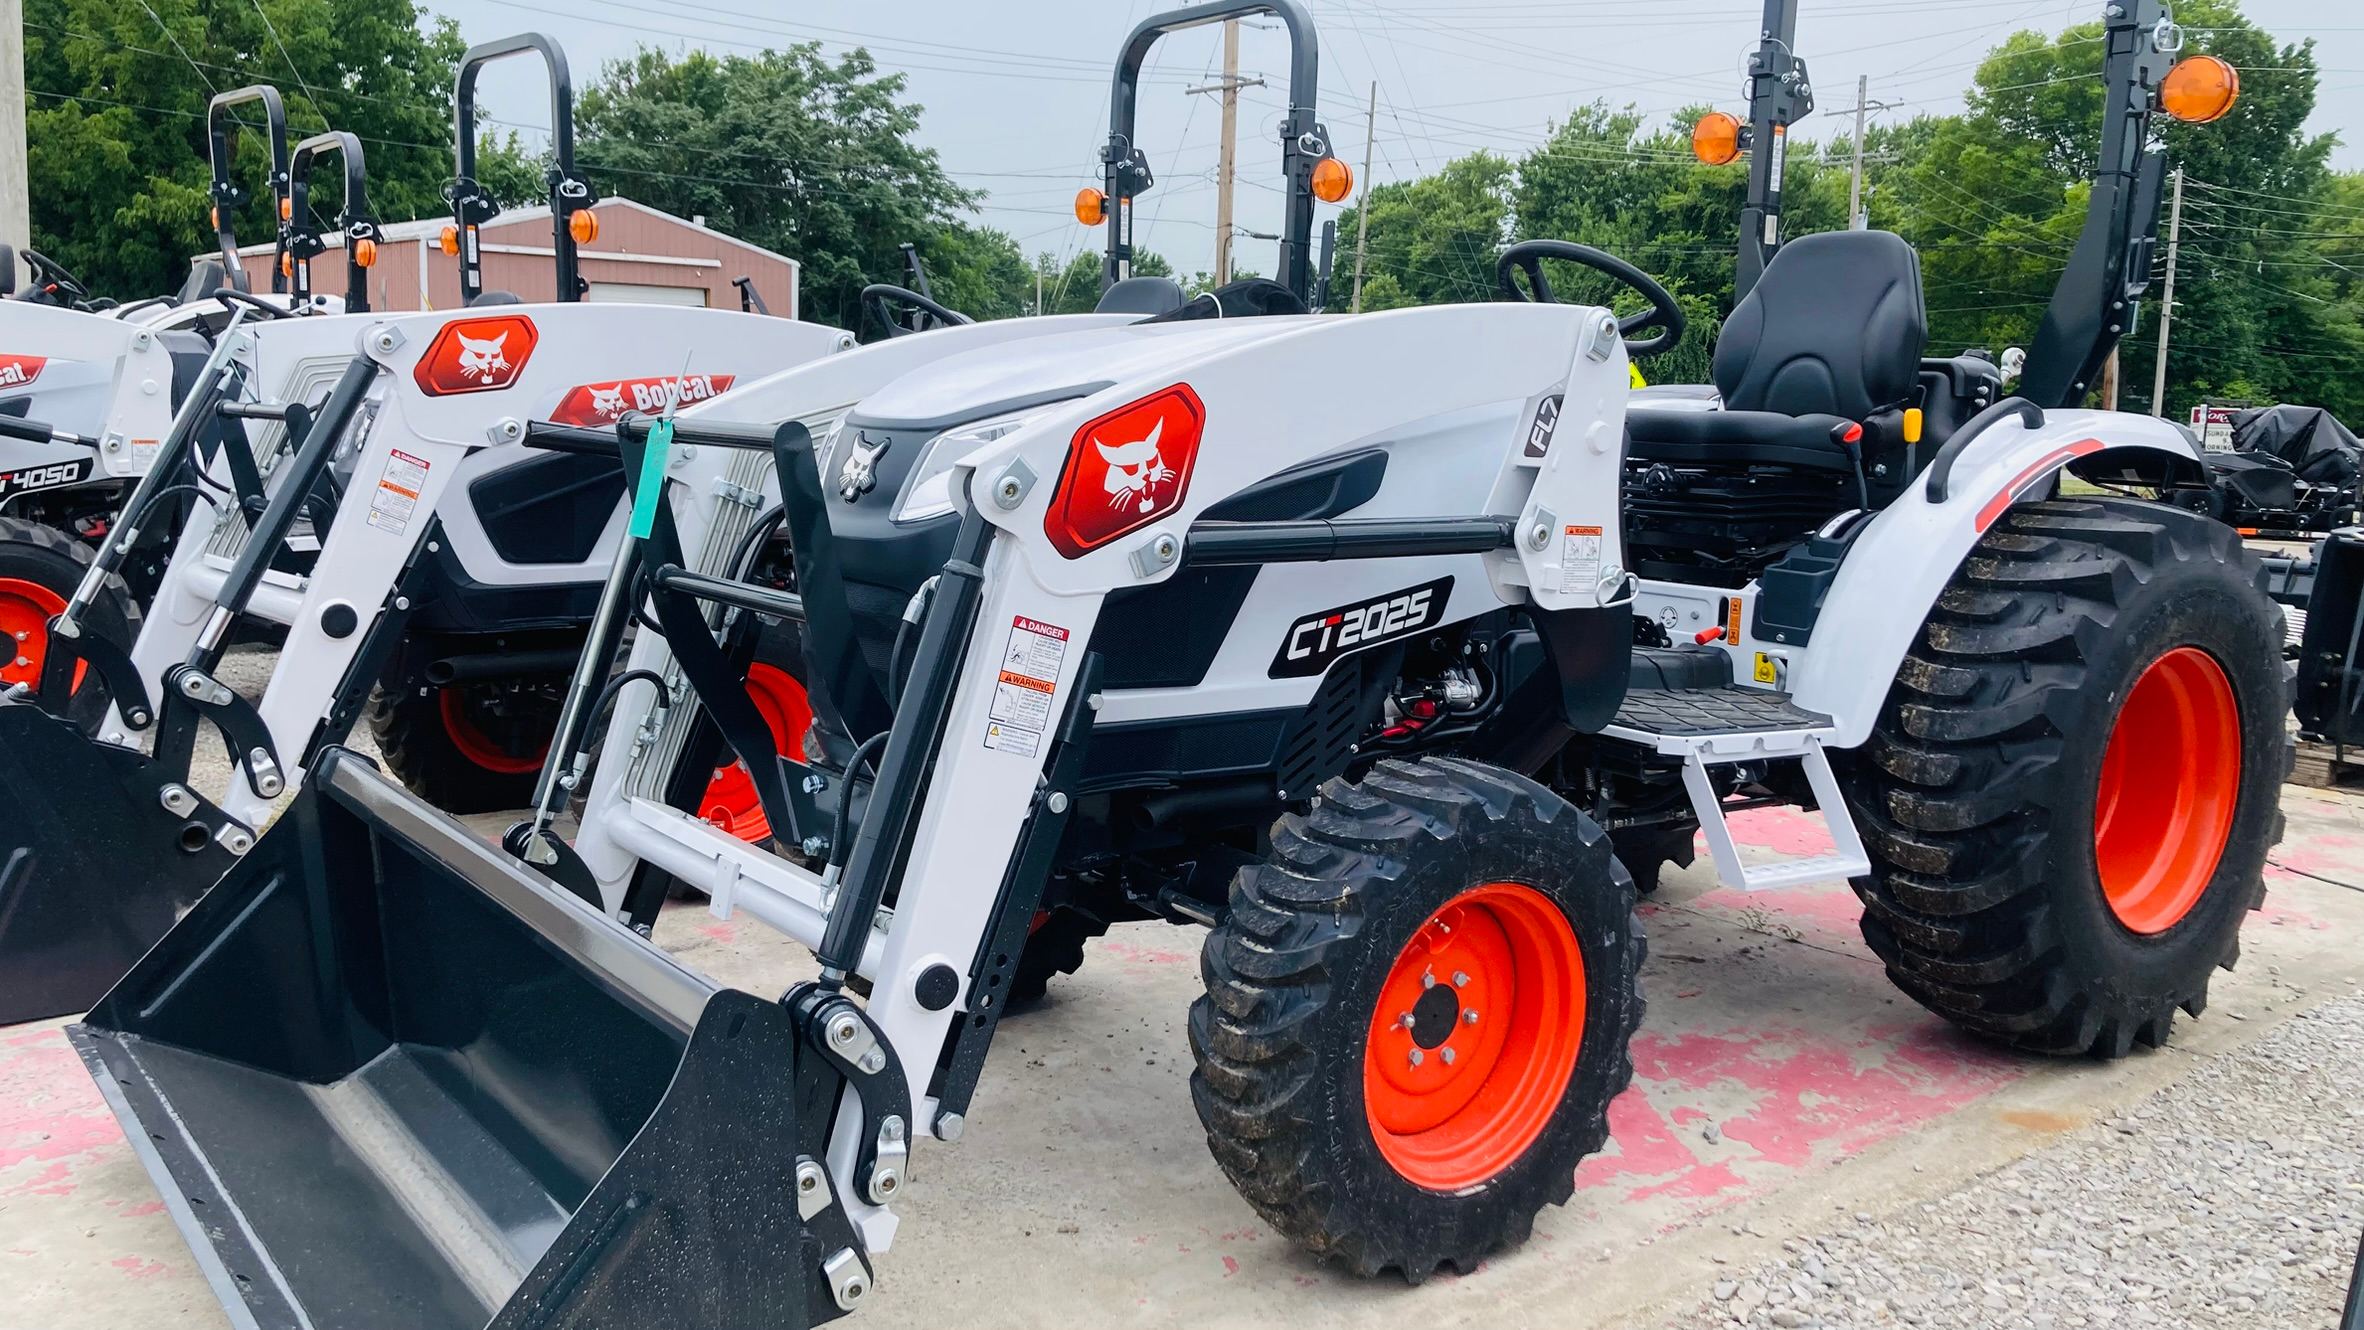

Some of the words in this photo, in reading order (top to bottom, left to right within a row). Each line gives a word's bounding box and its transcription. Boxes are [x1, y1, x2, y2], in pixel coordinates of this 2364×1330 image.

[631, 375, 717, 411] Bobcat
[1531, 397, 1558, 452] FL7
[1027, 621, 1064, 638] DANGER
[1287, 588, 1433, 661] CT2025
[1013, 675, 1050, 692] WARNING
